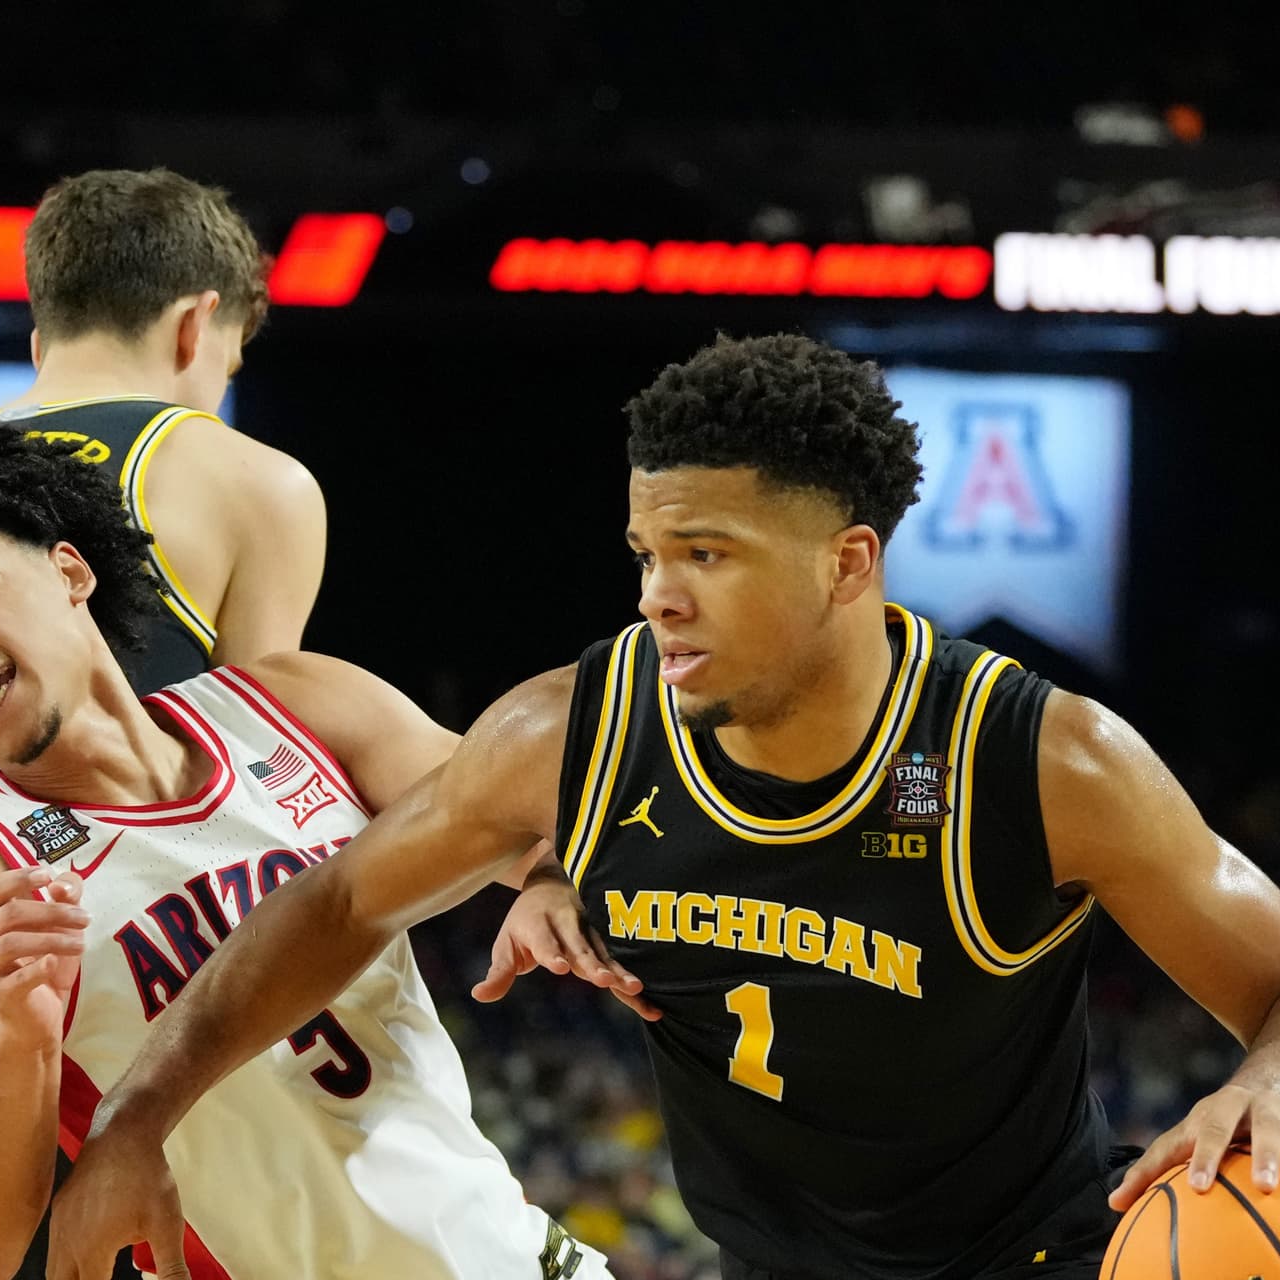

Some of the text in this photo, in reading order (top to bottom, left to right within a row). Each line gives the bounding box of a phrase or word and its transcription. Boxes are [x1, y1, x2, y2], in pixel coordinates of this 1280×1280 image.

[922, 401, 1075, 550] A
[895, 766, 939, 782] FINAL
[897, 798, 939, 814] FOUR
[25, 811, 65, 836] FINAL
[41, 827, 79, 853] FOUR
[113, 837, 353, 1024] ARIZO
[604, 889, 923, 999] MICHIGAN
[725, 981, 784, 1102] 1
